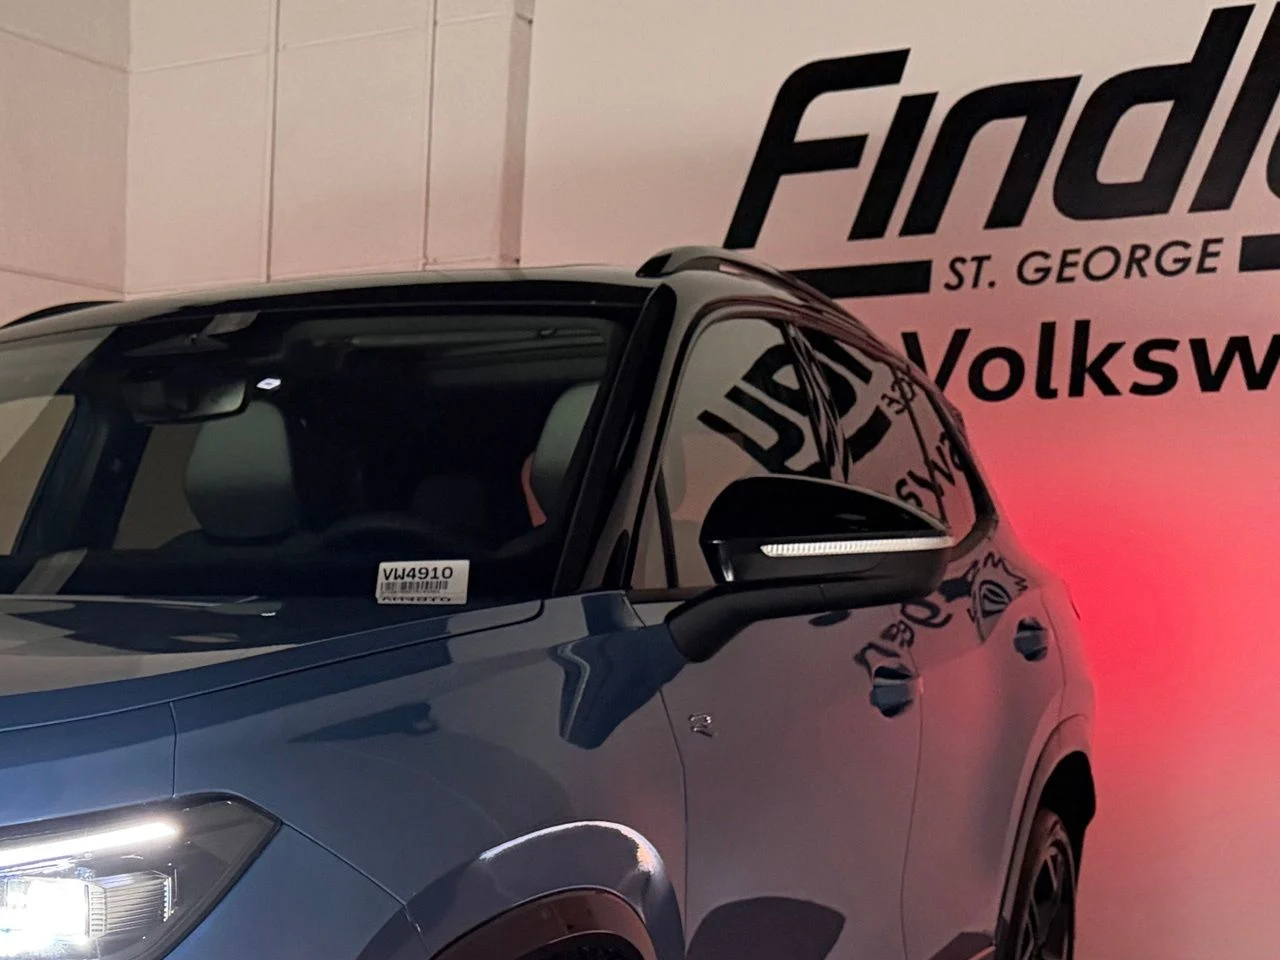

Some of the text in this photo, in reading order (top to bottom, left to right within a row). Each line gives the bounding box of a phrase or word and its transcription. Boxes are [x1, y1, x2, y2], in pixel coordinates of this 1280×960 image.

[723, 2, 1280, 251] Findl
[943, 238, 1224, 291] ST. GEORGE
[901, 319, 1280, 402] Volksw
[382, 566, 454, 581] VW4910
